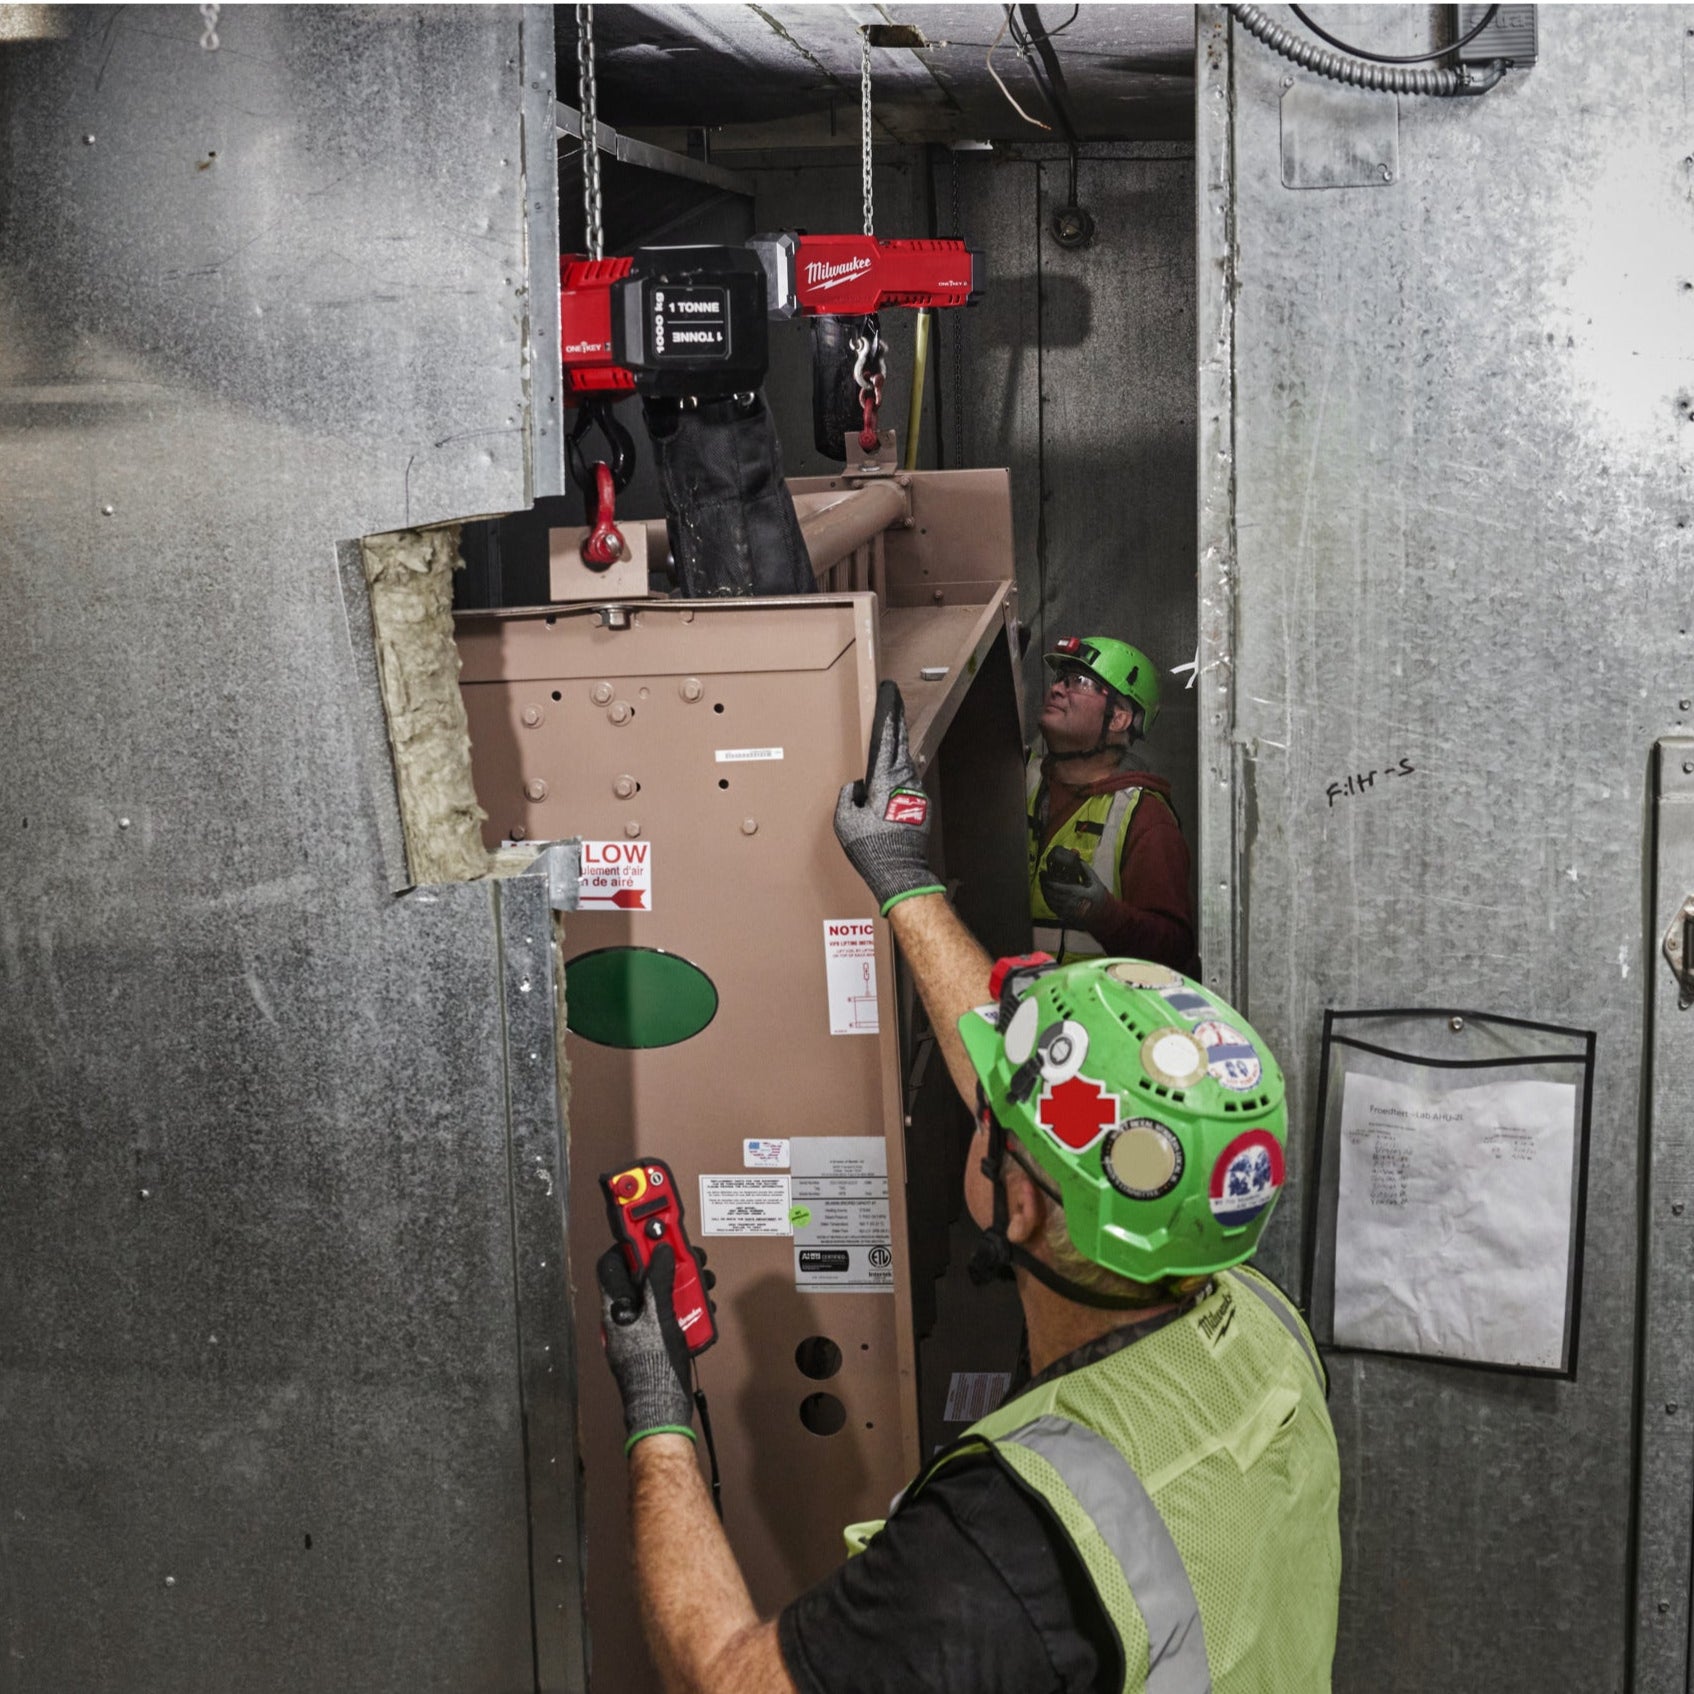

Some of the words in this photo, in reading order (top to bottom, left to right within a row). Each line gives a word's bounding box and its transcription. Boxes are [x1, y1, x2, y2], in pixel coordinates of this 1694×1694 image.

[804, 256, 872, 284] Milwaukee
[654, 291, 665, 312] kg
[668, 302, 676, 313] 1
[677, 301, 720, 313] TONNE
[655, 314, 665, 354] 1000
[671, 331, 715, 343] TONNE
[716, 331, 724, 342] 1
[622, 865, 644, 876] d'air
[592, 876, 608, 887] de
